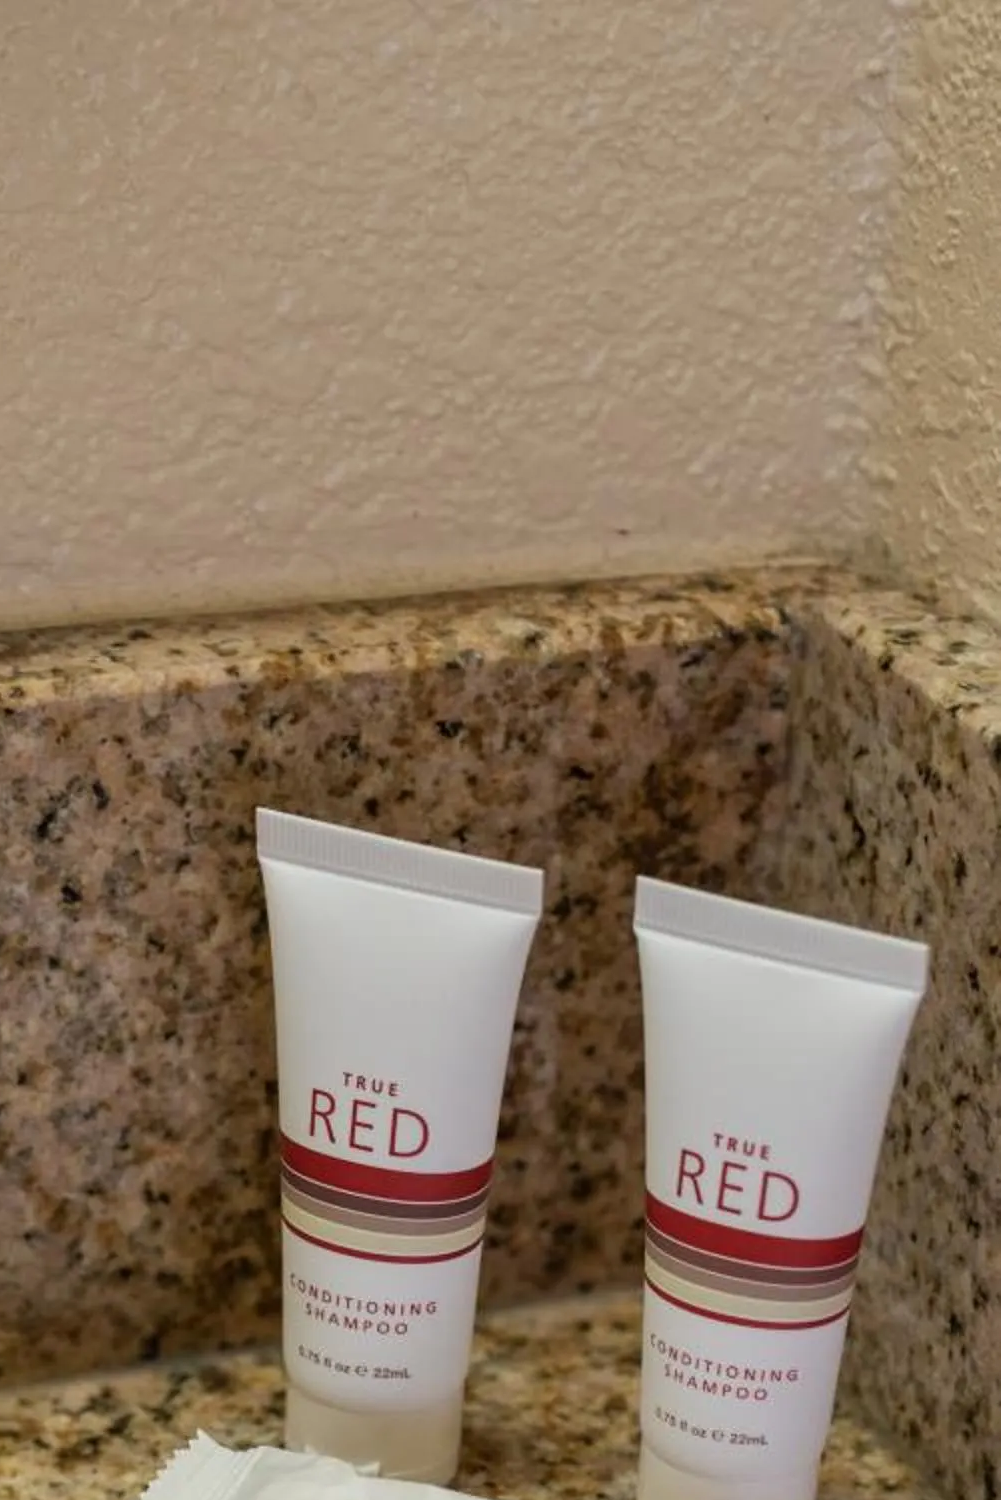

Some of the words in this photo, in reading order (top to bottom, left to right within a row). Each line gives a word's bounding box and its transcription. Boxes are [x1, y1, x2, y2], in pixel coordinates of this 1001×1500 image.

[342, 1072, 400, 1097] TRUE
[309, 1088, 430, 1158] RED
[713, 1133, 772, 1161] TRUE
[676, 1148, 800, 1222] RED
[289, 1272, 439, 1317] CONDITIONING
[305, 1302, 409, 1335] SHAMPOO
[334, 1363, 351, 1375] oz
[650, 1333, 800, 1383] CONDITIONING
[664, 1363, 769, 1401] SHAMPOO
[691, 1426, 708, 1439] oz
